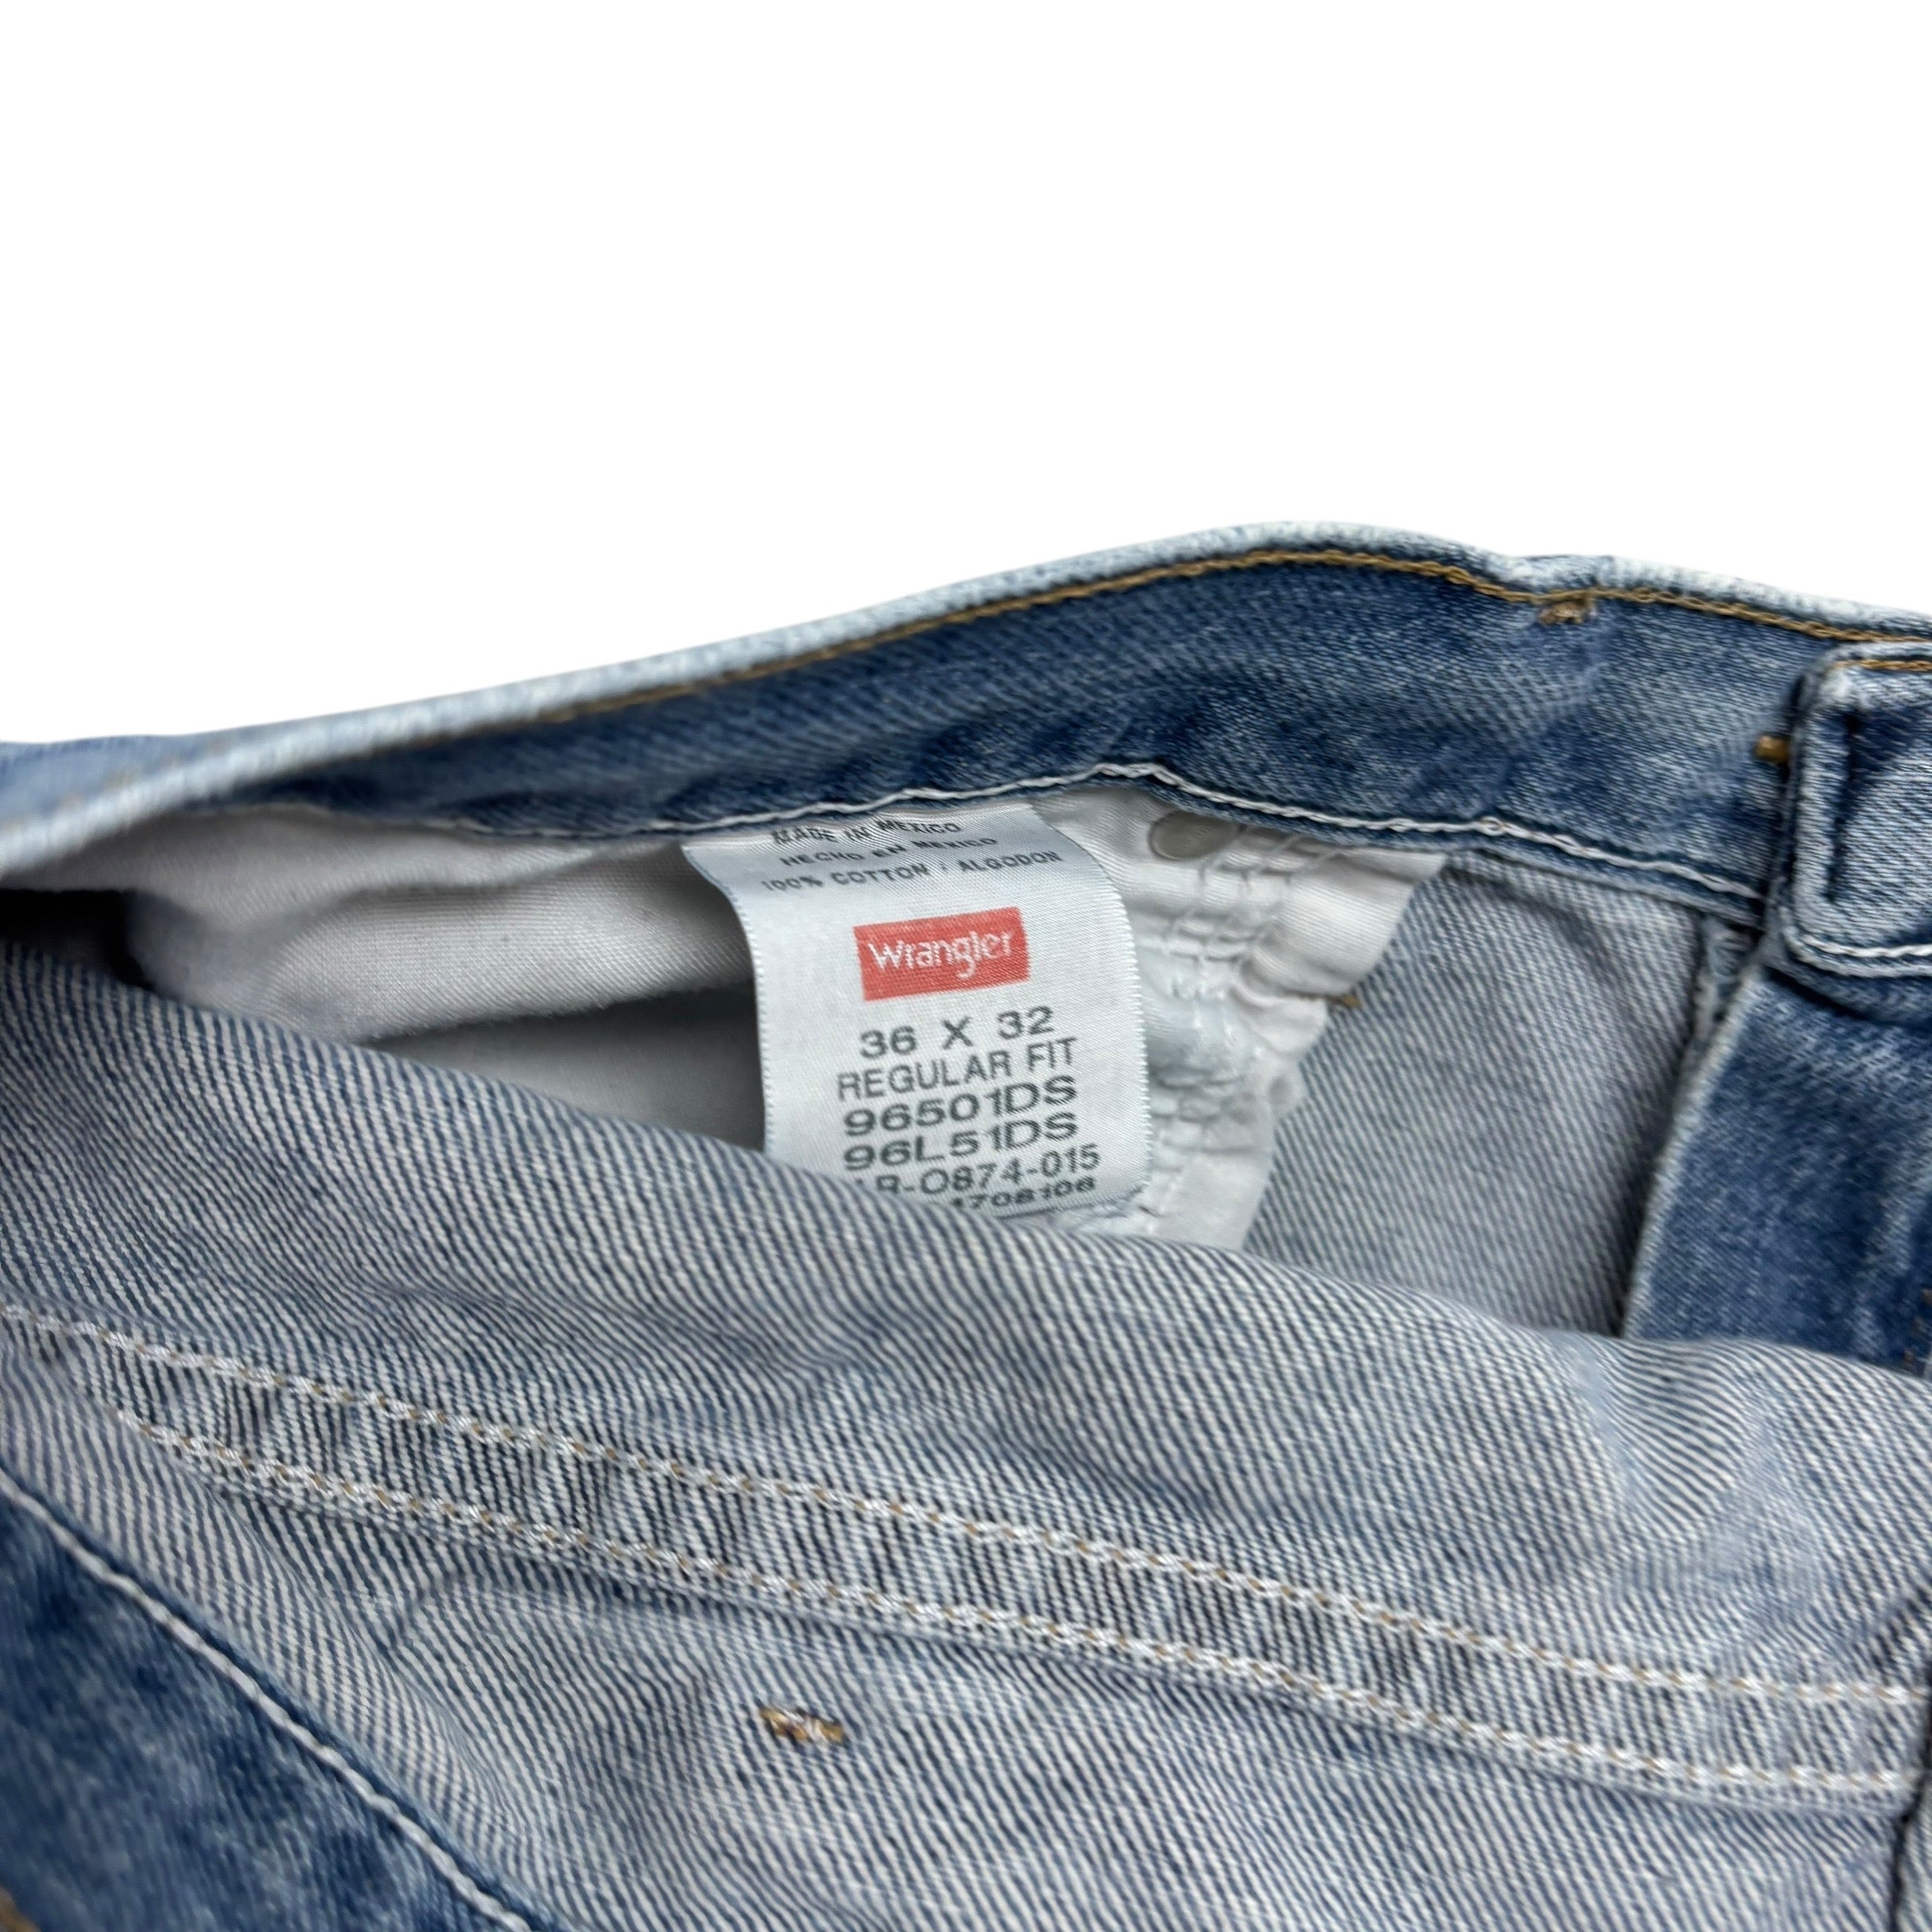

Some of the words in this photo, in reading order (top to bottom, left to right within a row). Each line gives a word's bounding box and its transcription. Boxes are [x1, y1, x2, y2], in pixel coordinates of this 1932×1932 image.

[773, 826, 837, 845] MADE
[844, 827, 870, 841] IN
[877, 820, 961, 834] MEXICO
[779, 851, 865, 866] HECHO
[872, 845, 907, 857] EN
[911, 838, 997, 849] MEXICO
[762, 875, 823, 891] 100%
[830, 863, 931, 886] COTTON
[958, 850, 1063, 873] ALGODON
[868, 930, 1013, 979] Wrangler
[860, 1026, 917, 1059] 36
[943, 1018, 973, 1050] X
[998, 1005, 1055, 1039] 32
[838, 1051, 1011, 1100] REGULAR
[1028, 1038, 1078, 1072] FIT
[844, 1075, 1077, 1137] 96501DS
[844, 1112, 1077, 1171] 96L51DS
